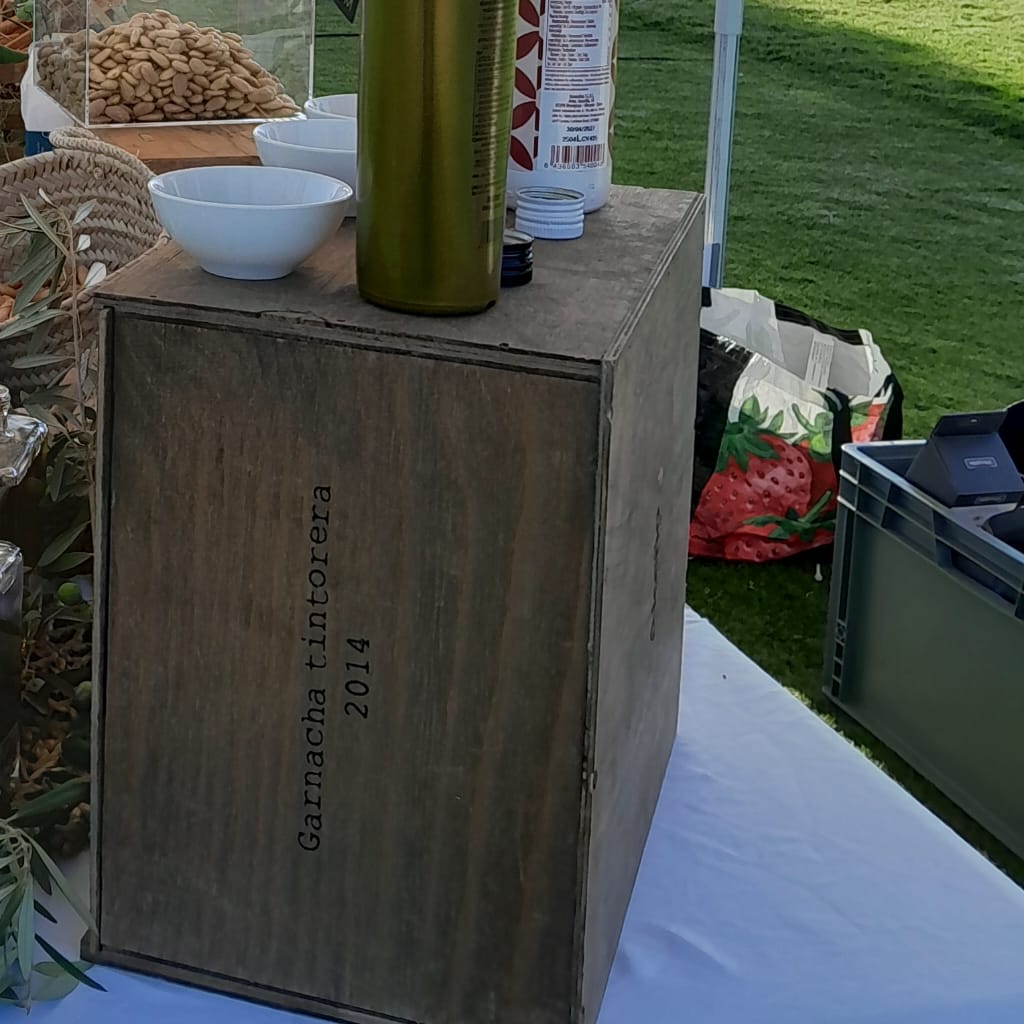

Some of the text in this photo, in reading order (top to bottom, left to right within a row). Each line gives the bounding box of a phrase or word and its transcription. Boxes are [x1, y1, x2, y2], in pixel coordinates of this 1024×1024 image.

[298, 485, 332, 852] Garnacha tintorera
[344, 637, 371, 719] 2014
